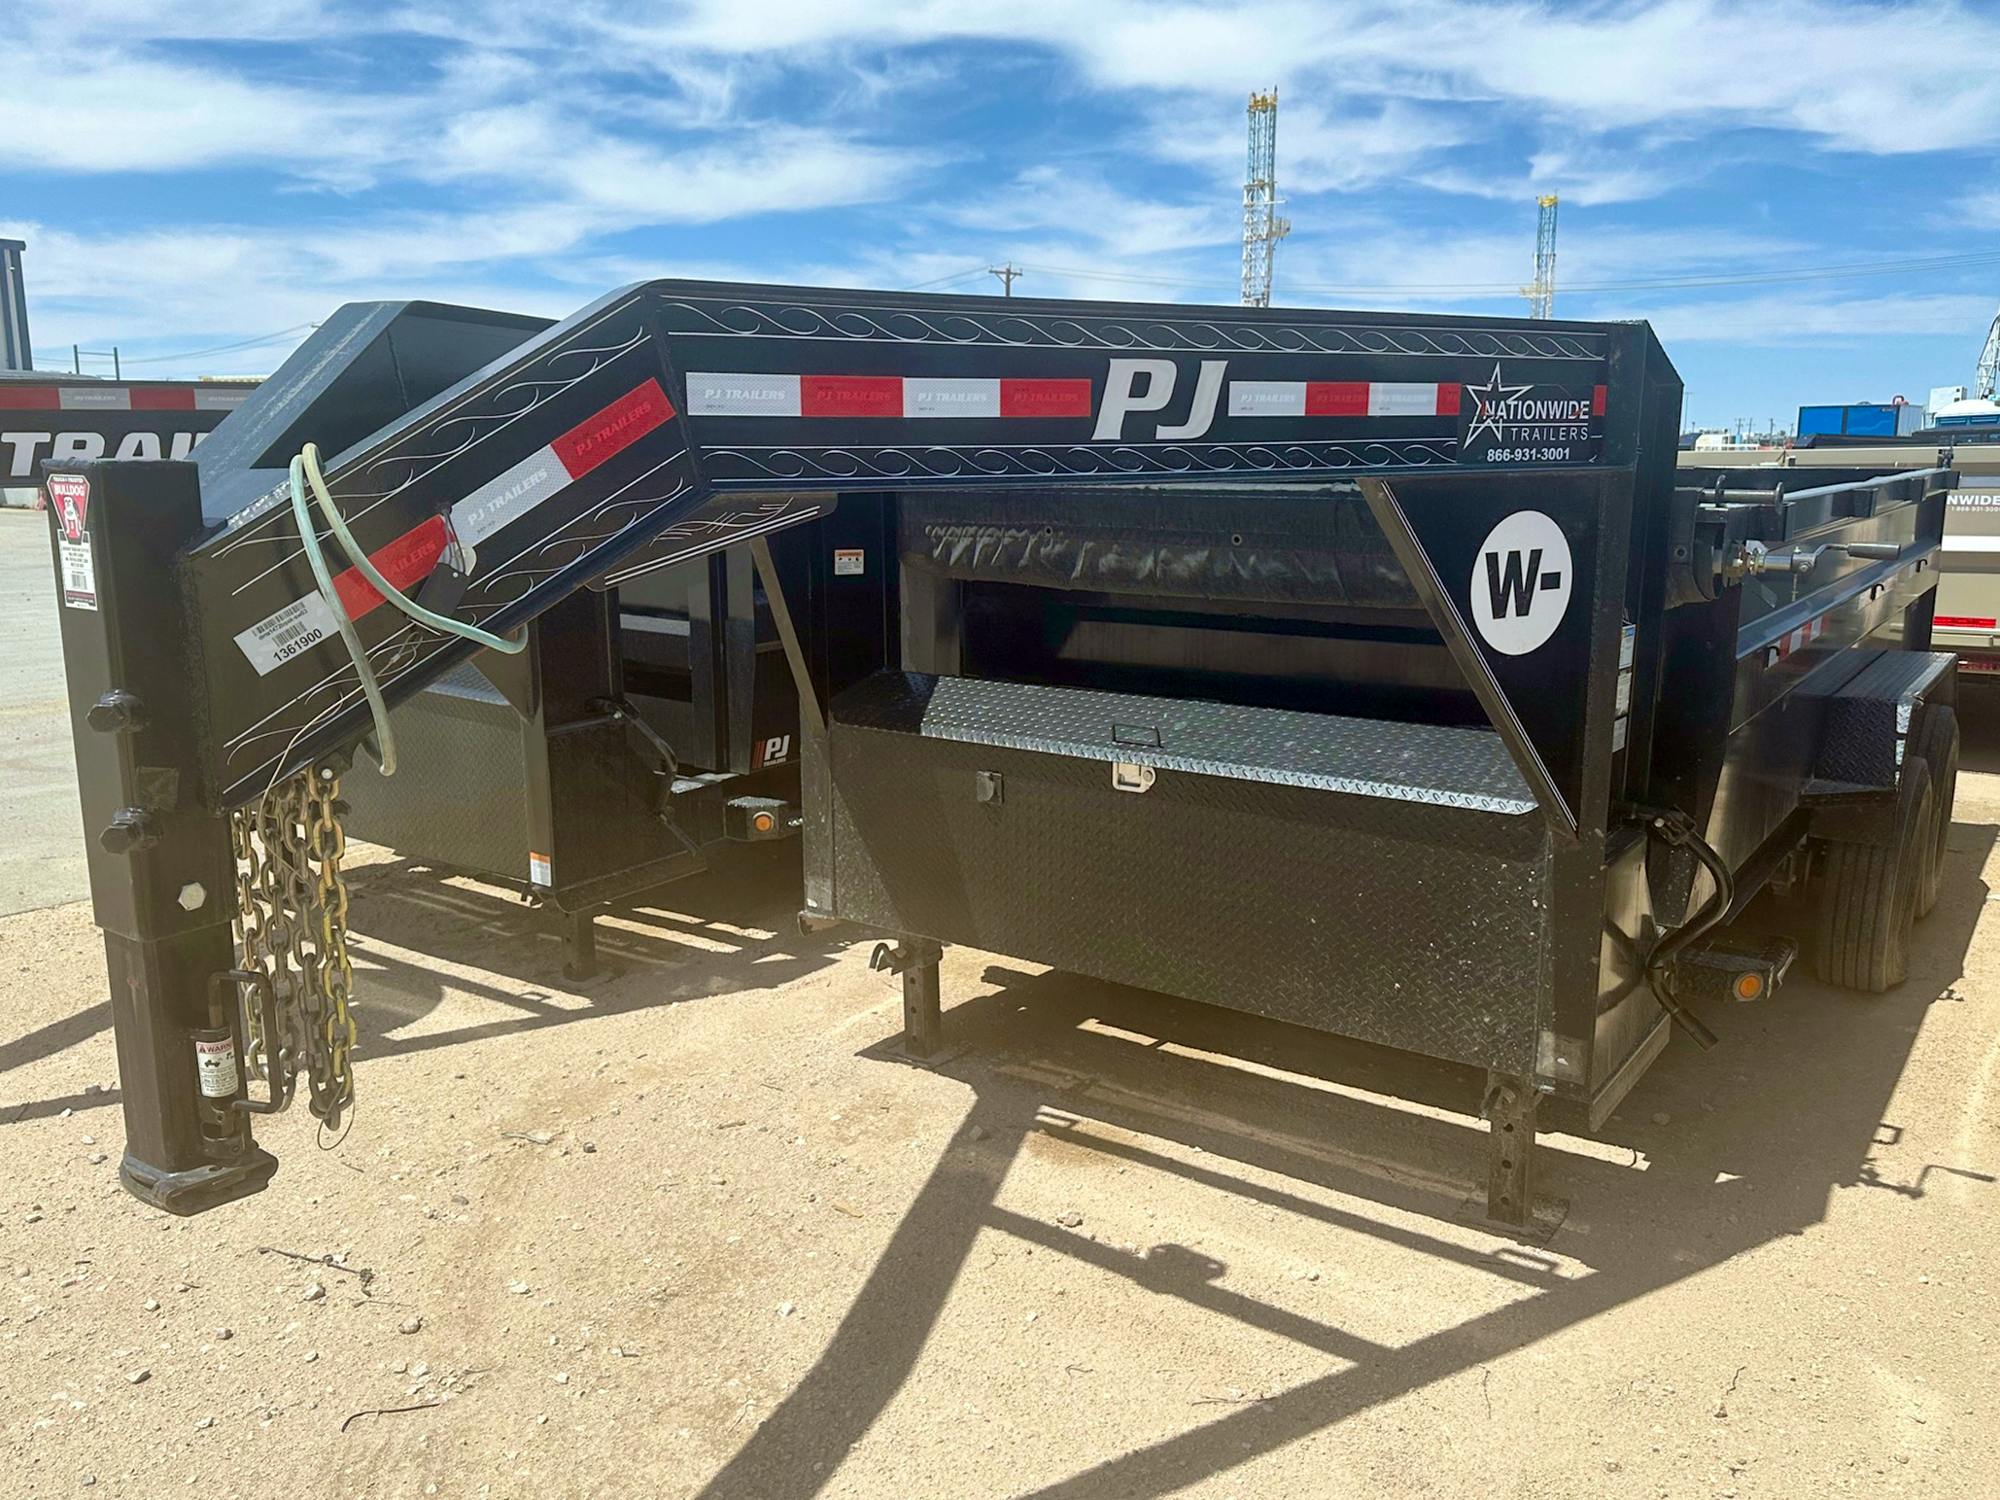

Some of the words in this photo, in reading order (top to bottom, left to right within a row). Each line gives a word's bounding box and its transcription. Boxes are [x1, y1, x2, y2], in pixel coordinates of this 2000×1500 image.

[705, 388, 721, 400] PJ
[724, 389, 786, 401] TRAILERS
[835, 391, 892, 402] TRAILERS
[918, 392, 931, 402] PJ
[935, 393, 987, 403] TRAILERS
[1091, 358, 1228, 440] PJ
[1482, 400, 1590, 420] NATIONWIDE
[576, 438, 593, 456] PJ
[594, 401, 652, 443] TRAILERS
[1511, 427, 1588, 441] TRAILERS
[1, 432, 210, 477] TRAI
[1486, 448, 1570, 462] 866-931-3001
[54, 483, 85, 497] BULLDOG
[467, 504, 486, 526] PJ
[486, 467, 549, 514] TRAILERS
[1485, 548, 1562, 620] W-
[273, 628, 323, 661] 1361900
[764, 734, 790, 761] PJ
